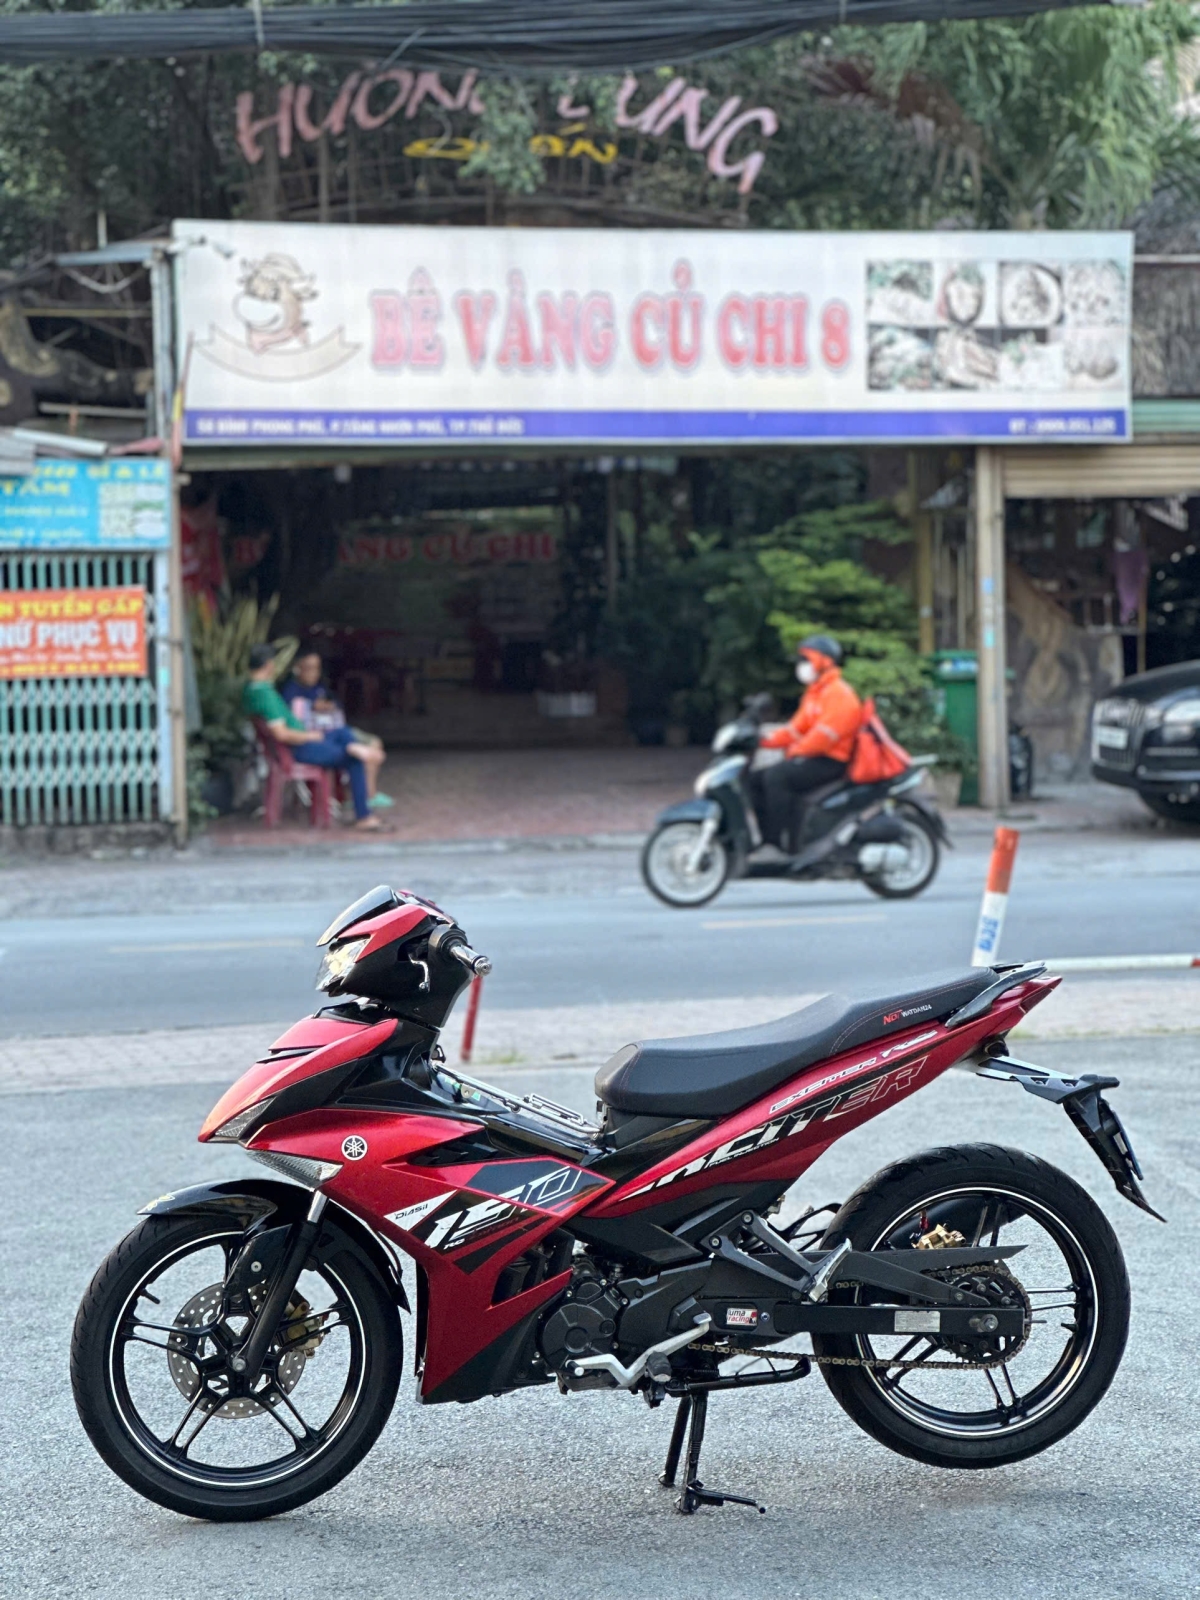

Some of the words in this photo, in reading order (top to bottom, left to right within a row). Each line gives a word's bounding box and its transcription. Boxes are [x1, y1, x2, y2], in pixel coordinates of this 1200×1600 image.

[368, 266, 446, 373] BÊ
[630, 258, 704, 376] CỦ
[717, 290, 811, 376] CHI
[820, 298, 853, 375] 8
[37, 620, 100, 653] PHỤC
[105, 619, 138, 652] VỤ
[424, 1165, 583, 1250] 150
